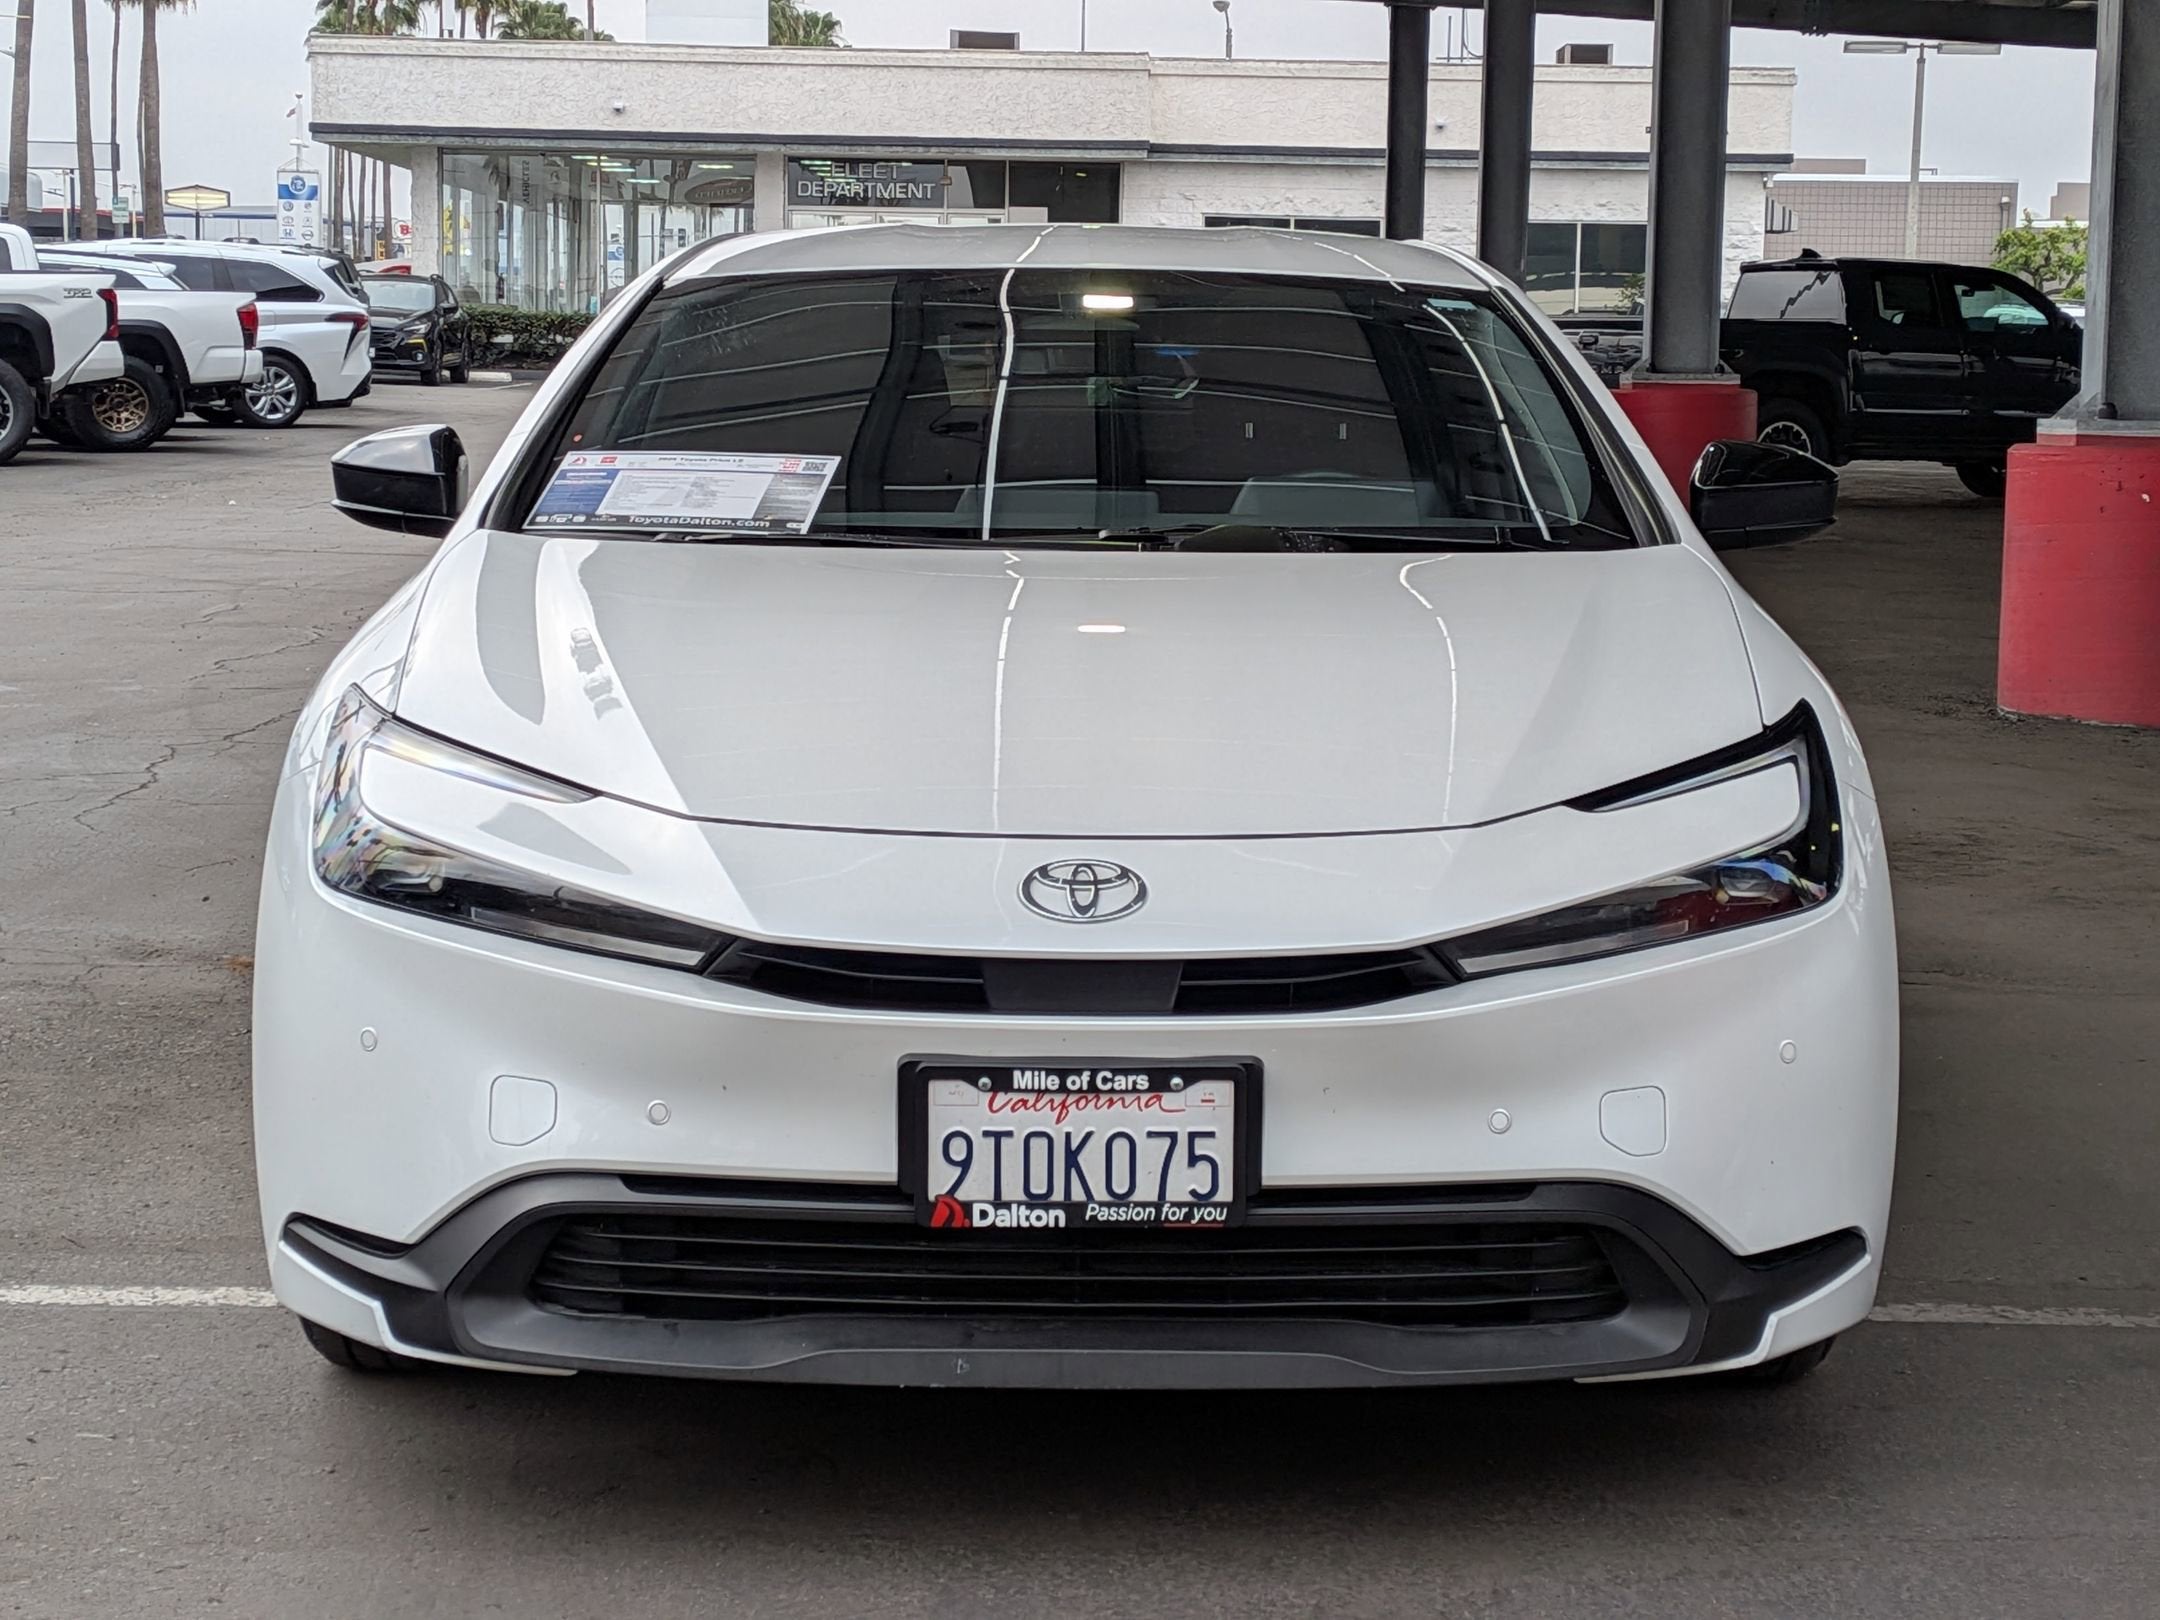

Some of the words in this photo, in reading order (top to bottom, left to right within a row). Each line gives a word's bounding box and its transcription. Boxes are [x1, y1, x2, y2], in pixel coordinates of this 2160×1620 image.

[797, 180, 936, 199] DEPARTMENT
[628, 515, 771, 529] ToyotaDalton.com
[1012, 1070, 1060, 1091] Mile
[1066, 1070, 1090, 1091] of
[1095, 1072, 1149, 1091] Cars
[986, 1090, 1186, 1126] California
[972, 1203, 1066, 1228] Dalton
[1085, 1202, 1156, 1222] Passion
[1160, 1202, 1188, 1222] for
[1191, 1206, 1228, 1224] you
